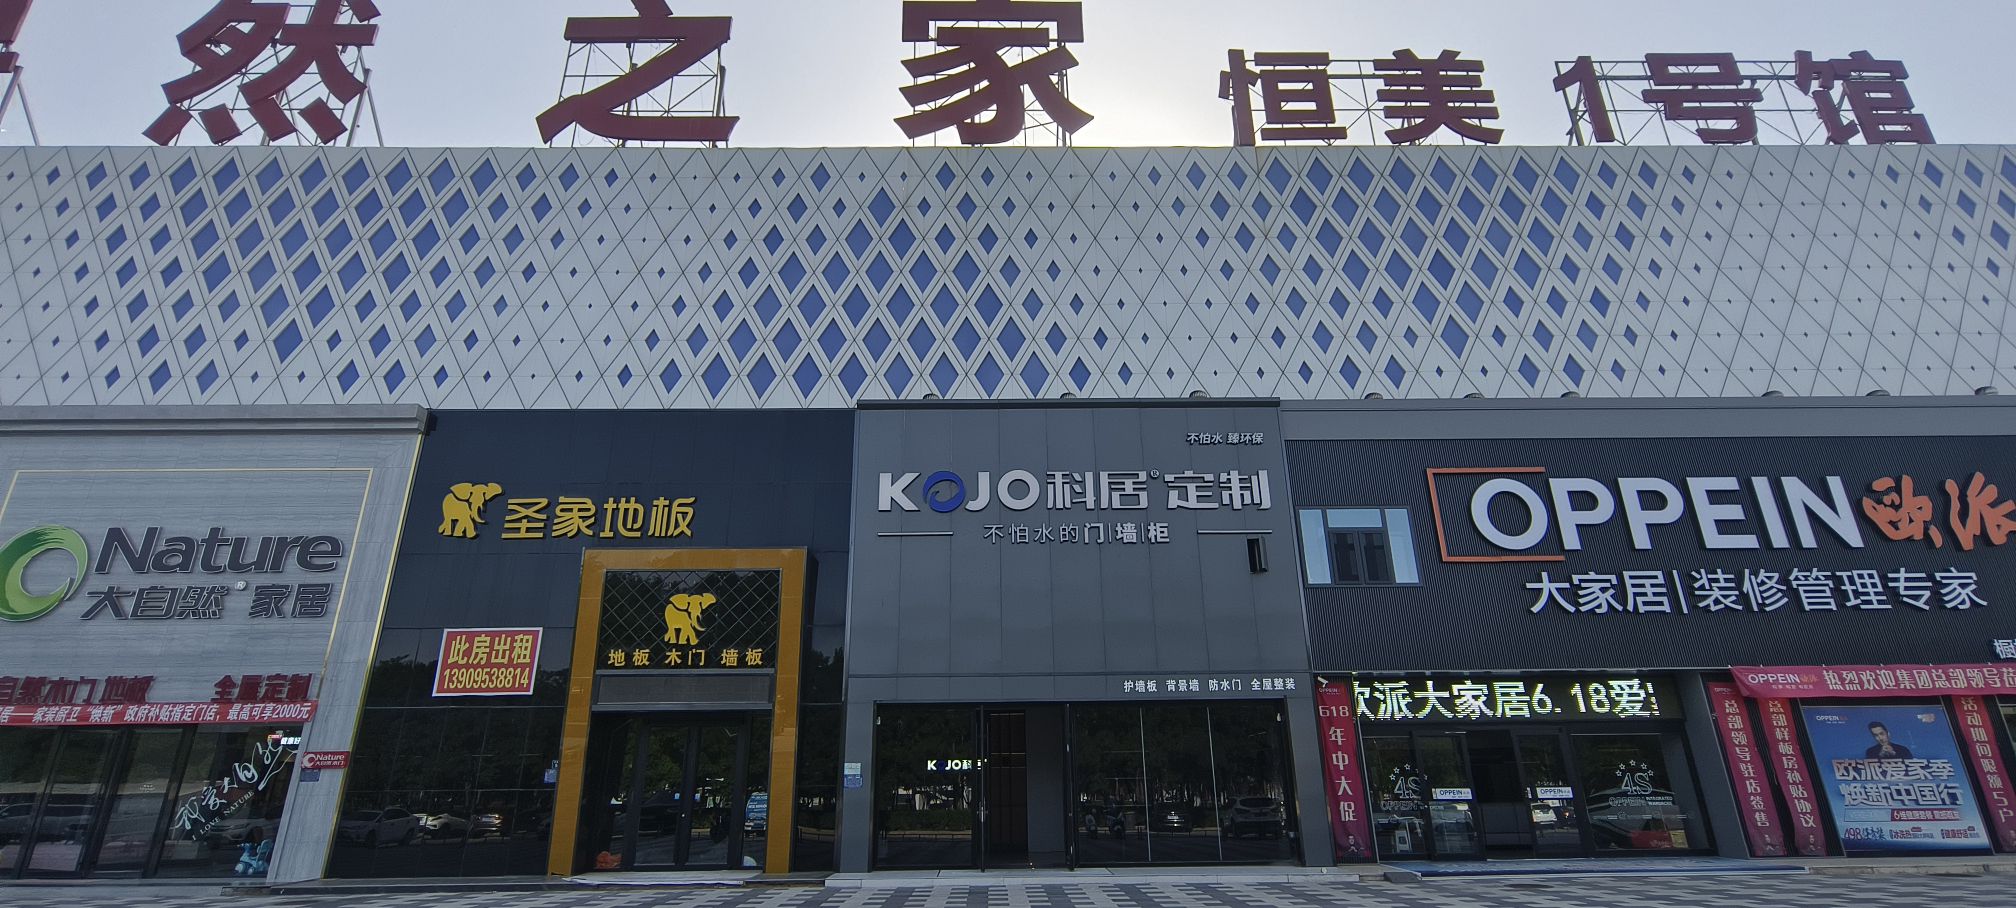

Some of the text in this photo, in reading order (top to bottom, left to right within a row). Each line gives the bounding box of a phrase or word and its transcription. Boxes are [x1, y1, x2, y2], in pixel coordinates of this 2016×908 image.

[1218, 50, 1934, 145] 恒美1号馆
[1187, 432, 1264, 445] 不怕水 臻环保
[501, 496, 698, 540] 圣象地板
[94, 526, 344, 574] Nature
[447, 634, 532, 666] 此房出租
[608, 648, 764, 667] 地板 木门 墙板
[444, 667, 530, 690] 13909538814
[1123, 678, 1296, 693] 护墙板 背景墙 防水门 全屋整装
[1748, 673, 1801, 684] OPPEIN
[1832, 758, 1955, 780] 欧派爱家季
[1840, 783, 1964, 806] 焕新中国行
